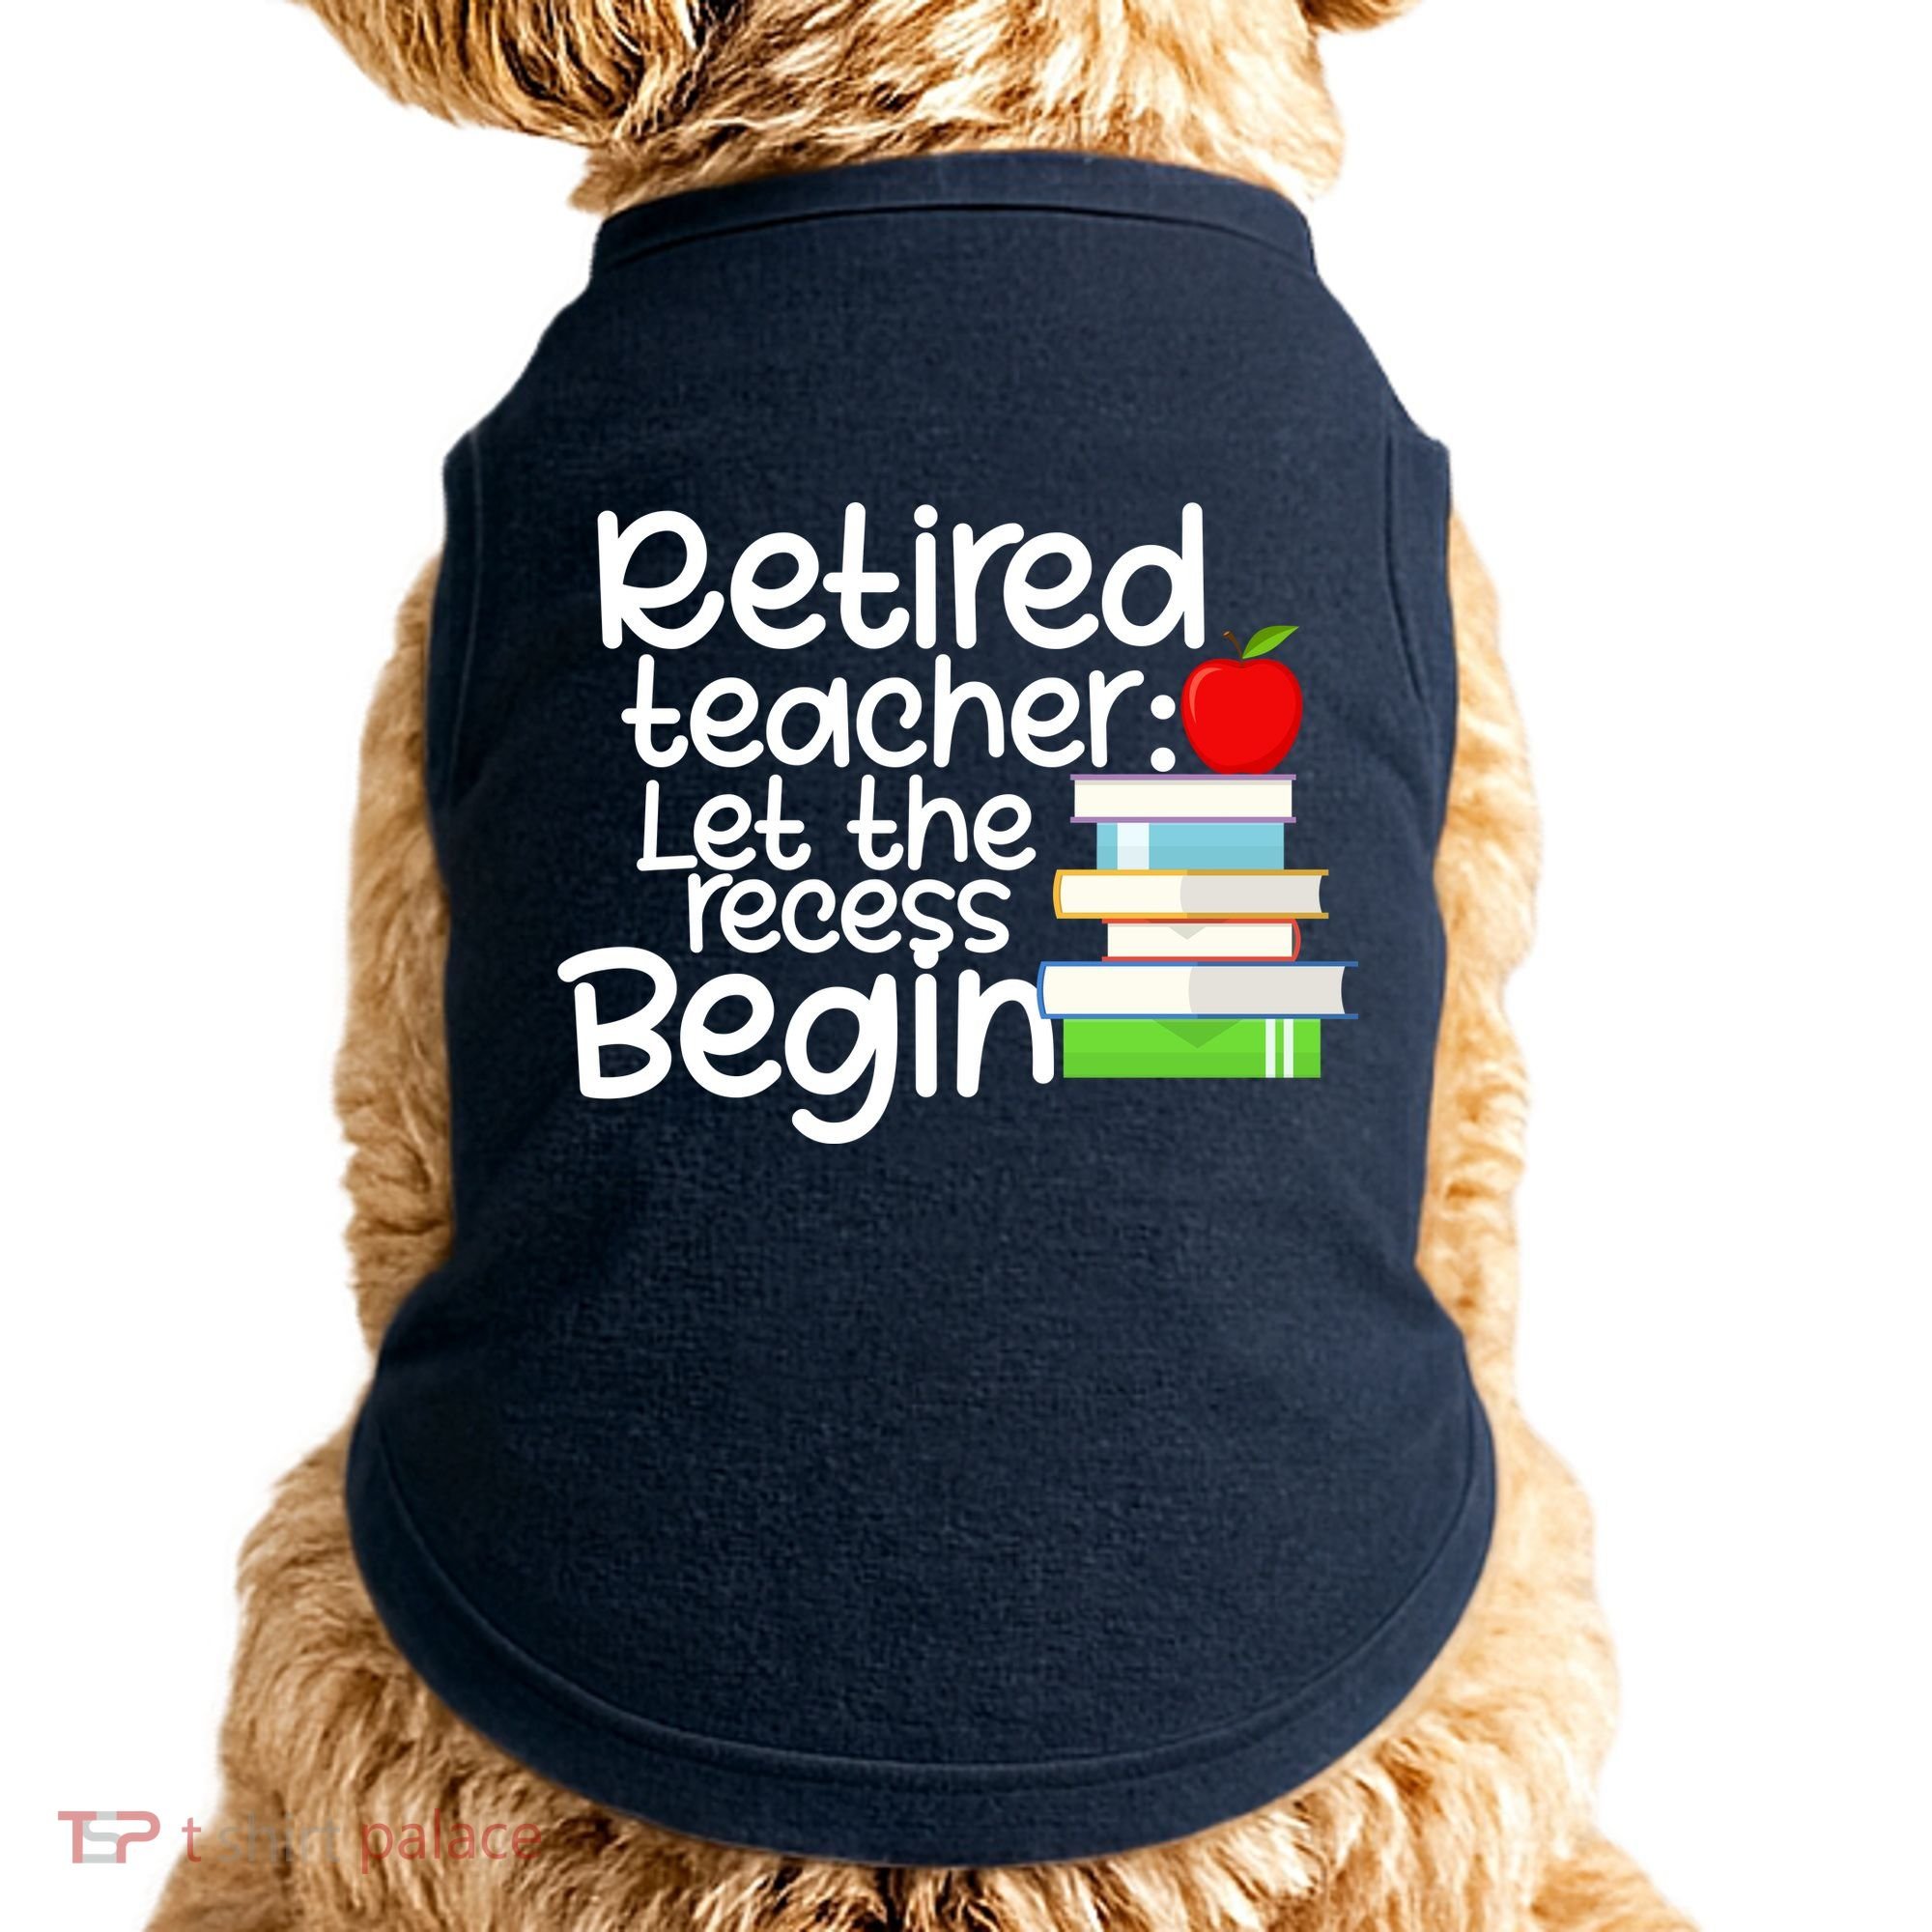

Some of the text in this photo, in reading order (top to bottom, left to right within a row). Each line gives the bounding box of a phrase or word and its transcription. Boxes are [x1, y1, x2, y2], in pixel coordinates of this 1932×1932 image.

[597, 501, 1205, 650] Retired
[621, 654, 1176, 772] teacher:
[636, 774, 1037, 871] Let the
[688, 873, 1011, 954] recess
[557, 946, 1055, 1145] Begin
